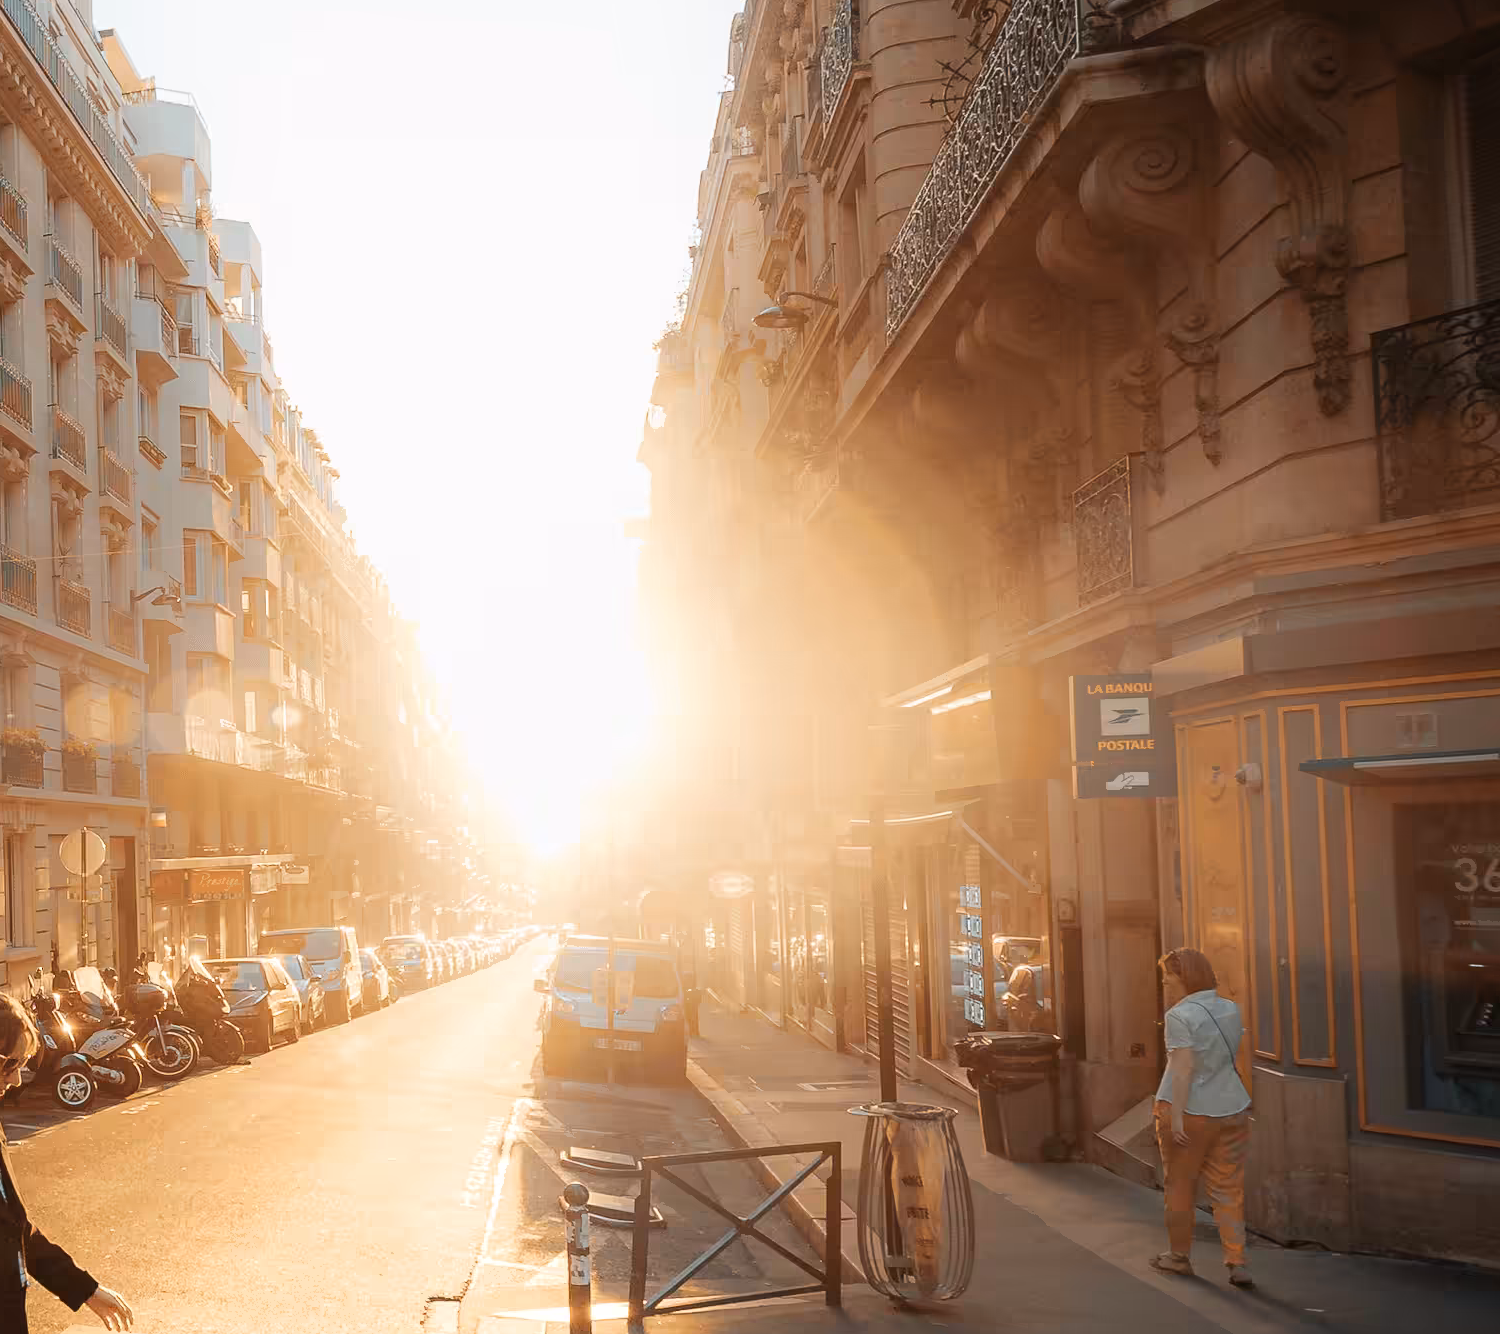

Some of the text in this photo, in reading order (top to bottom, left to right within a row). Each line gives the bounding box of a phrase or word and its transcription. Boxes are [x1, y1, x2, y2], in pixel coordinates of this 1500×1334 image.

[1087, 682, 1153, 695] LA BANQU
[1097, 739, 1155, 751] POSTALE
